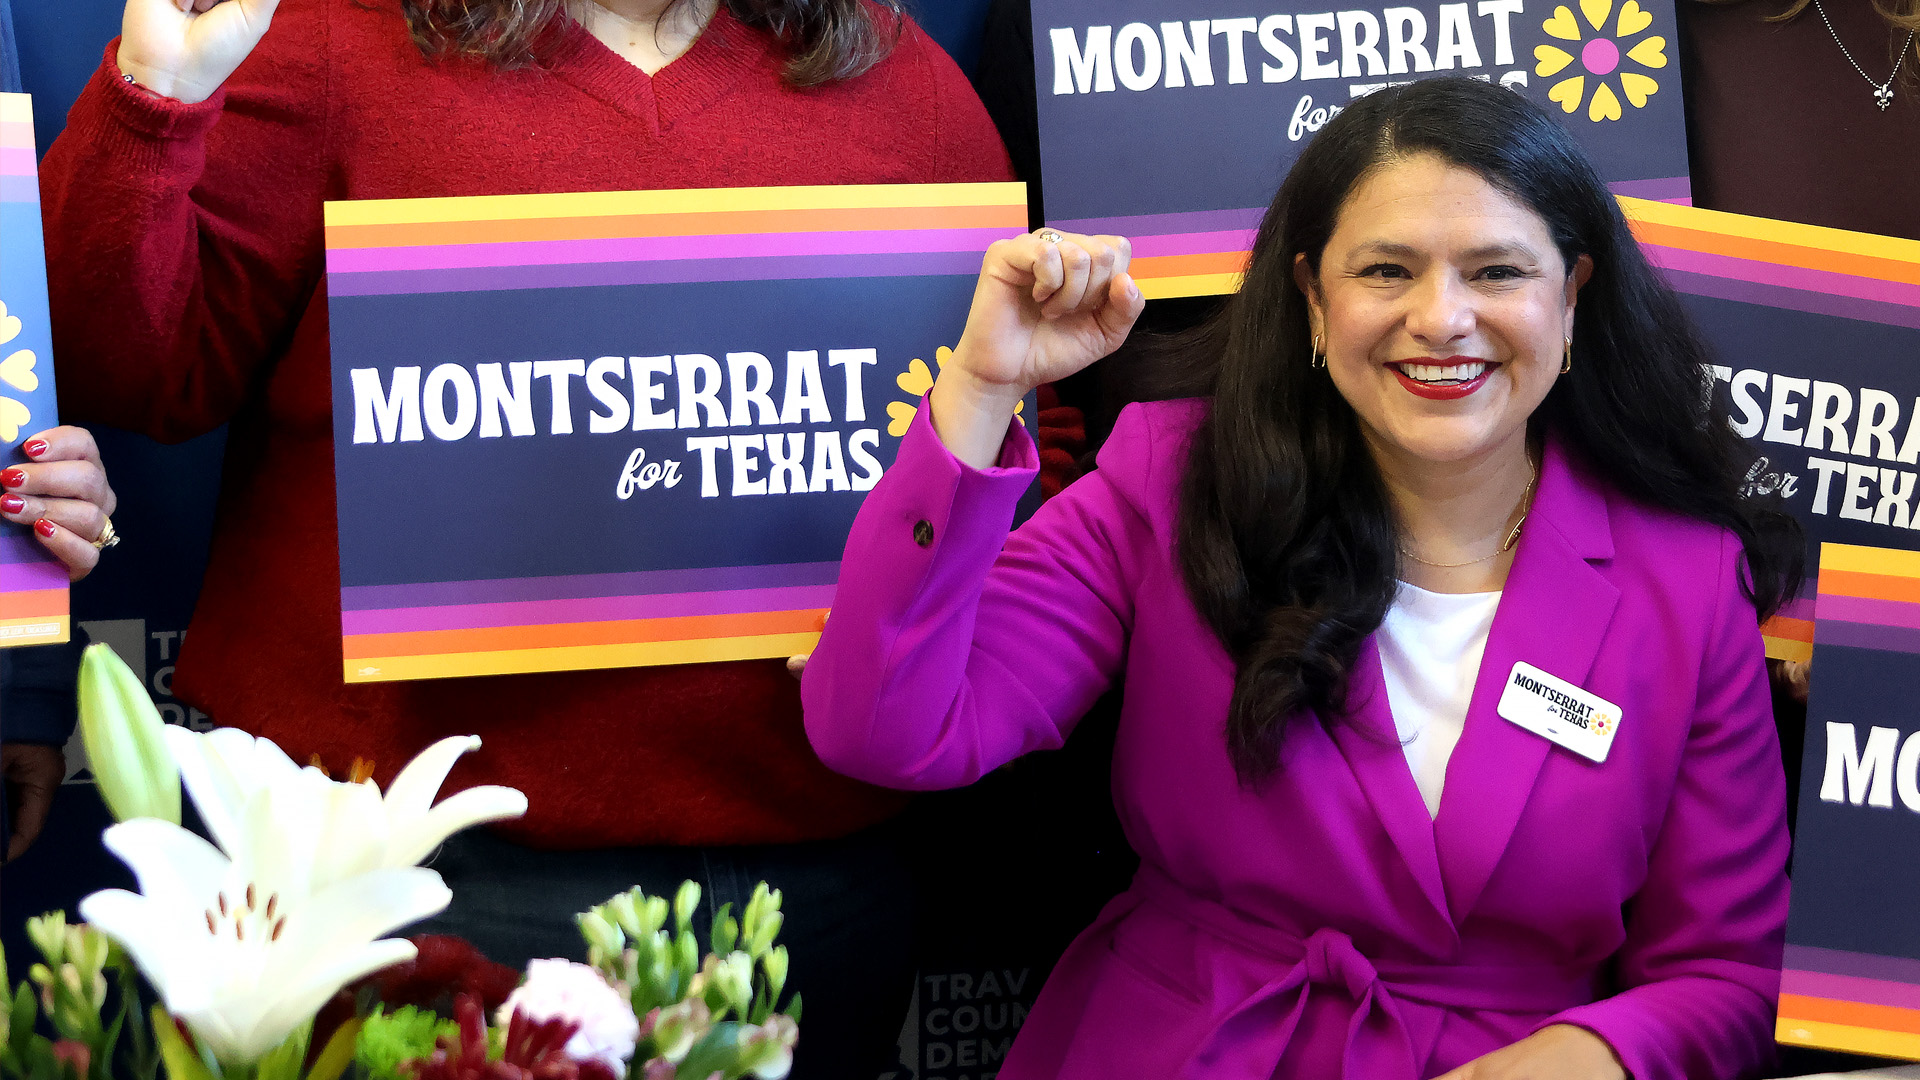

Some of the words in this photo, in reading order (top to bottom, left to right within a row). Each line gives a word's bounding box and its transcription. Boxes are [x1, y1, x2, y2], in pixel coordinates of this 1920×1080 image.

[1050, 0, 1524, 96] MONTSERRAT
[350, 347, 878, 445] MONTSERRAT
[615, 448, 683, 500] for
[686, 428, 884, 498] TEXAS
[1737, 456, 1799, 500] for
[1807, 456, 1920, 530] TEX
[1514, 673, 1594, 718] MONTSERRAT
[1547, 704, 1558, 714] for
[1559, 707, 1589, 729] TEXAS
